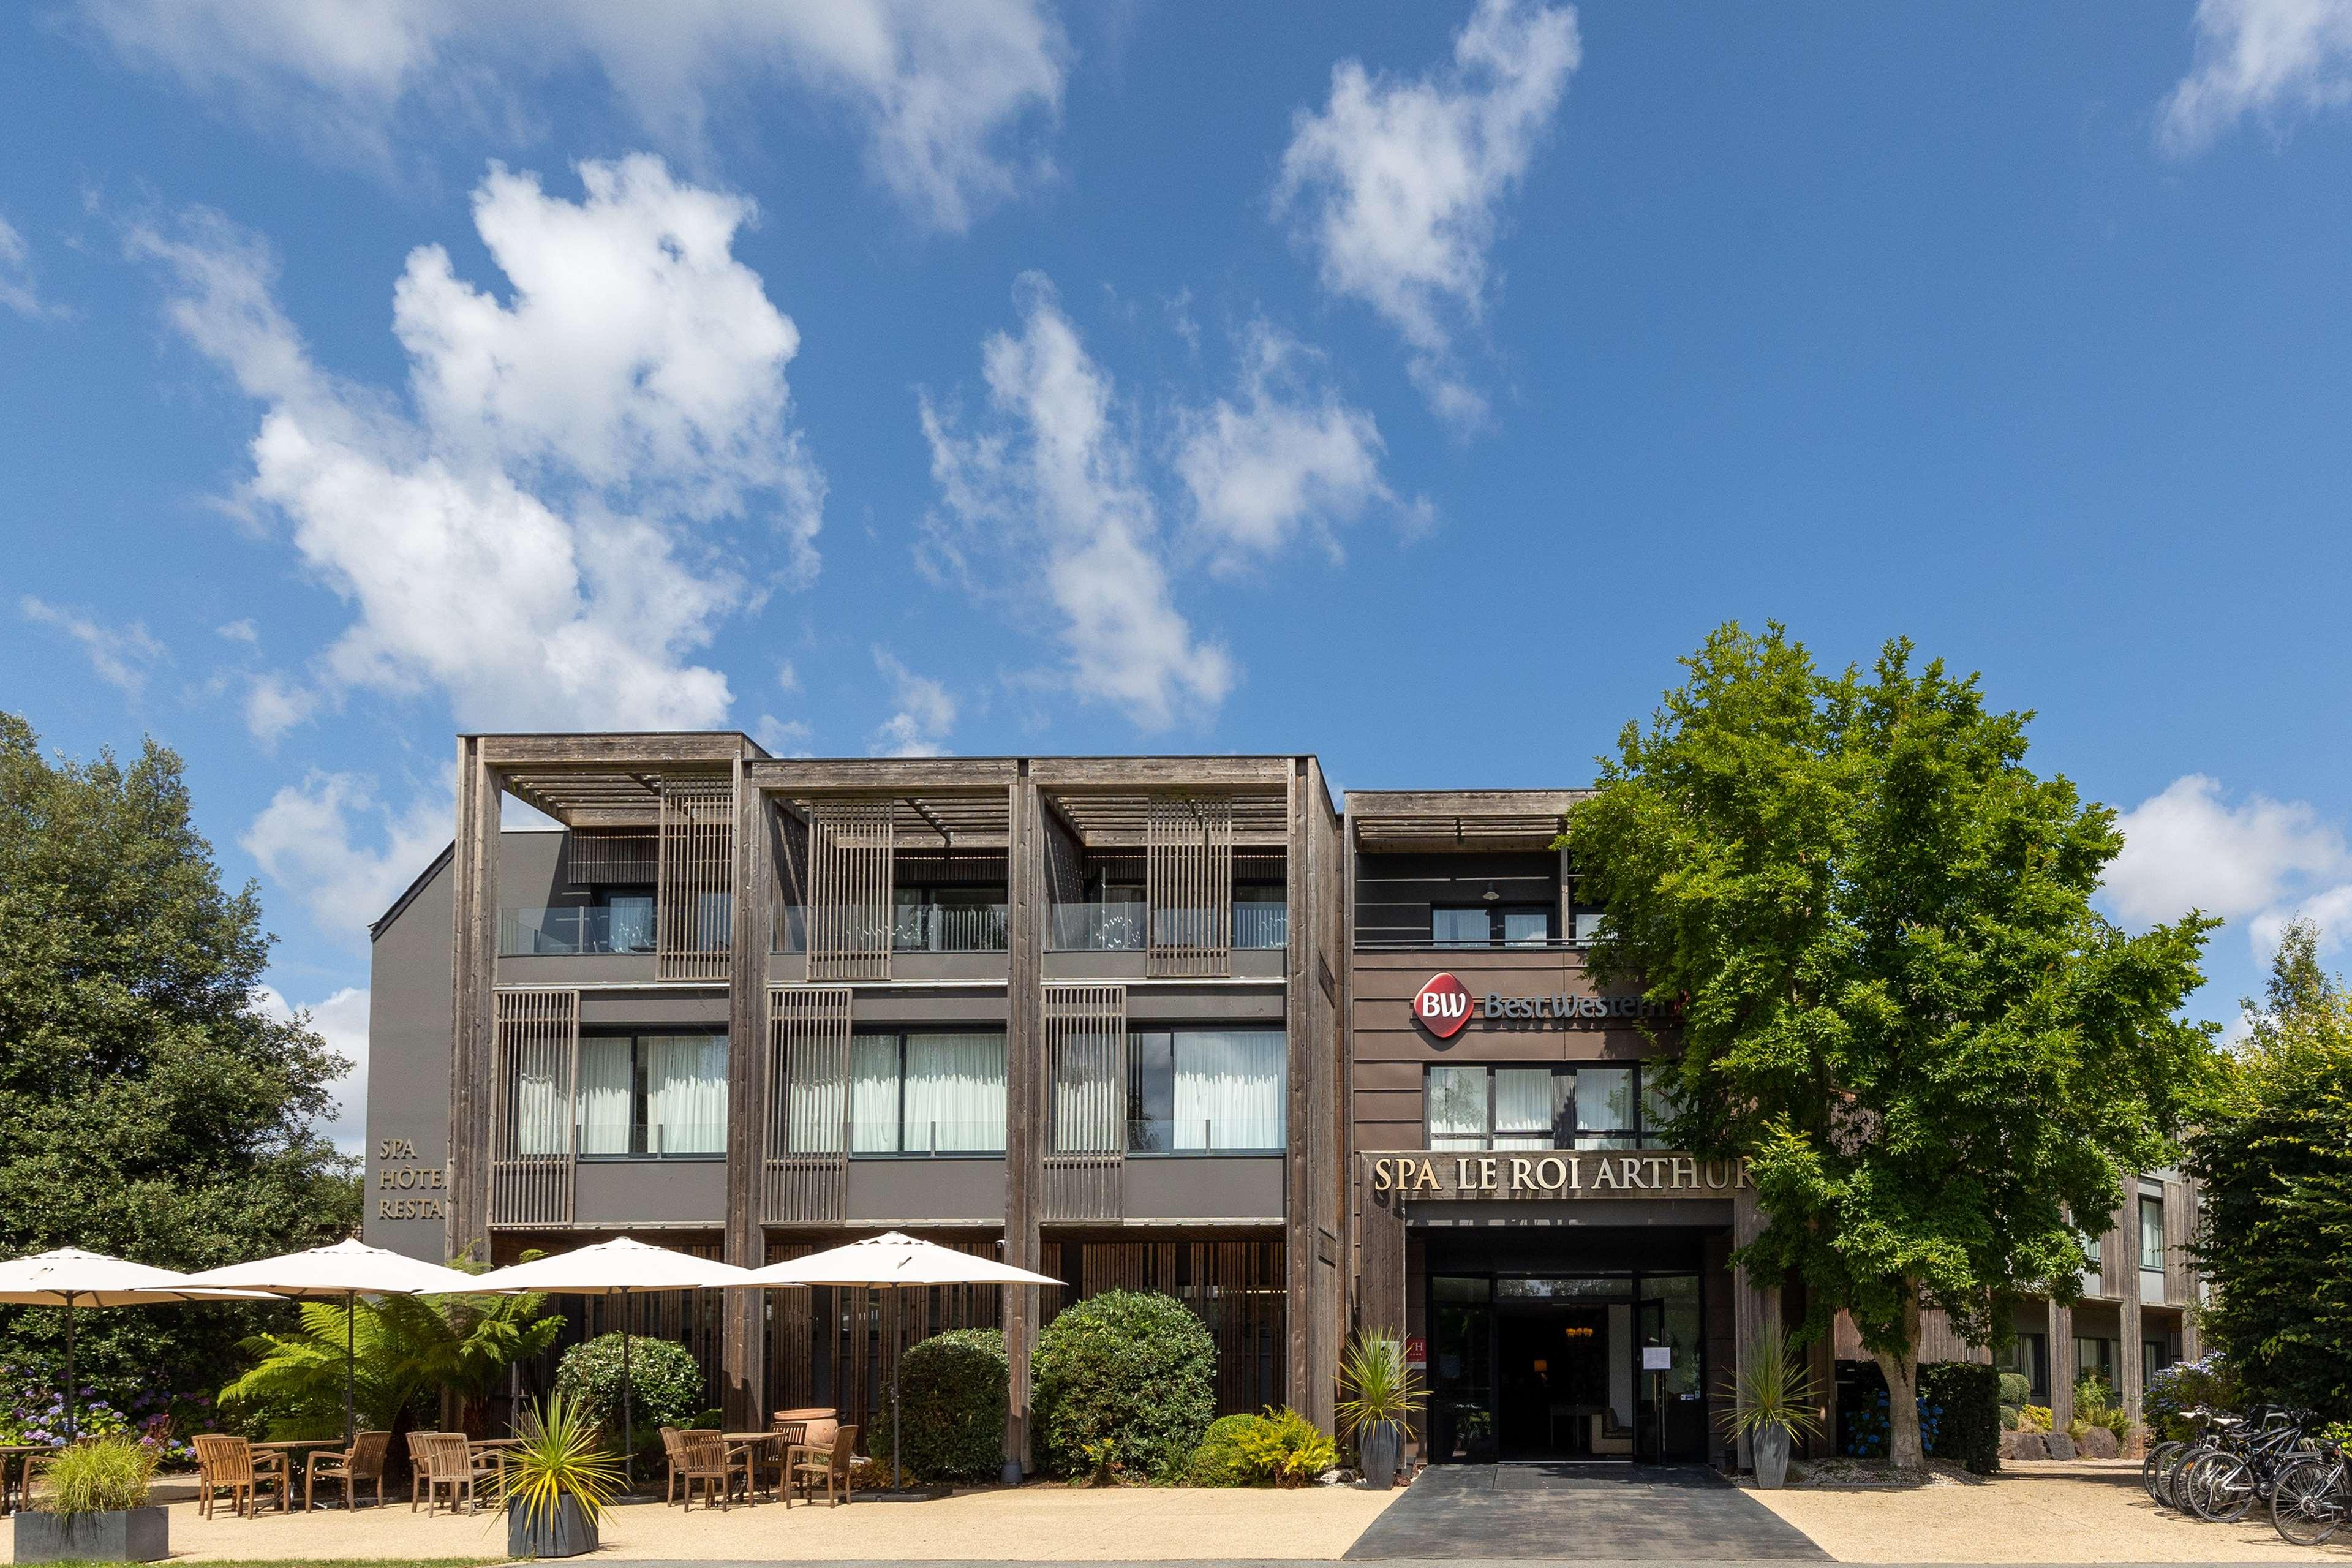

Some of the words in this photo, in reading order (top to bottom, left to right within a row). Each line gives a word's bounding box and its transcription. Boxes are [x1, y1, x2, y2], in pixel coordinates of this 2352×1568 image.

[1422, 992, 1466, 1017] BW
[1485, 992, 1545, 1019] Best
[380, 1138, 418, 1159] SPA
[1374, 1157, 1443, 1191] SPA
[1457, 1158, 1498, 1190] LE
[1510, 1158, 1582, 1191] ROI
[1591, 1157, 1757, 1190] ARTHUR
[379, 1199, 446, 1220] RESTA
